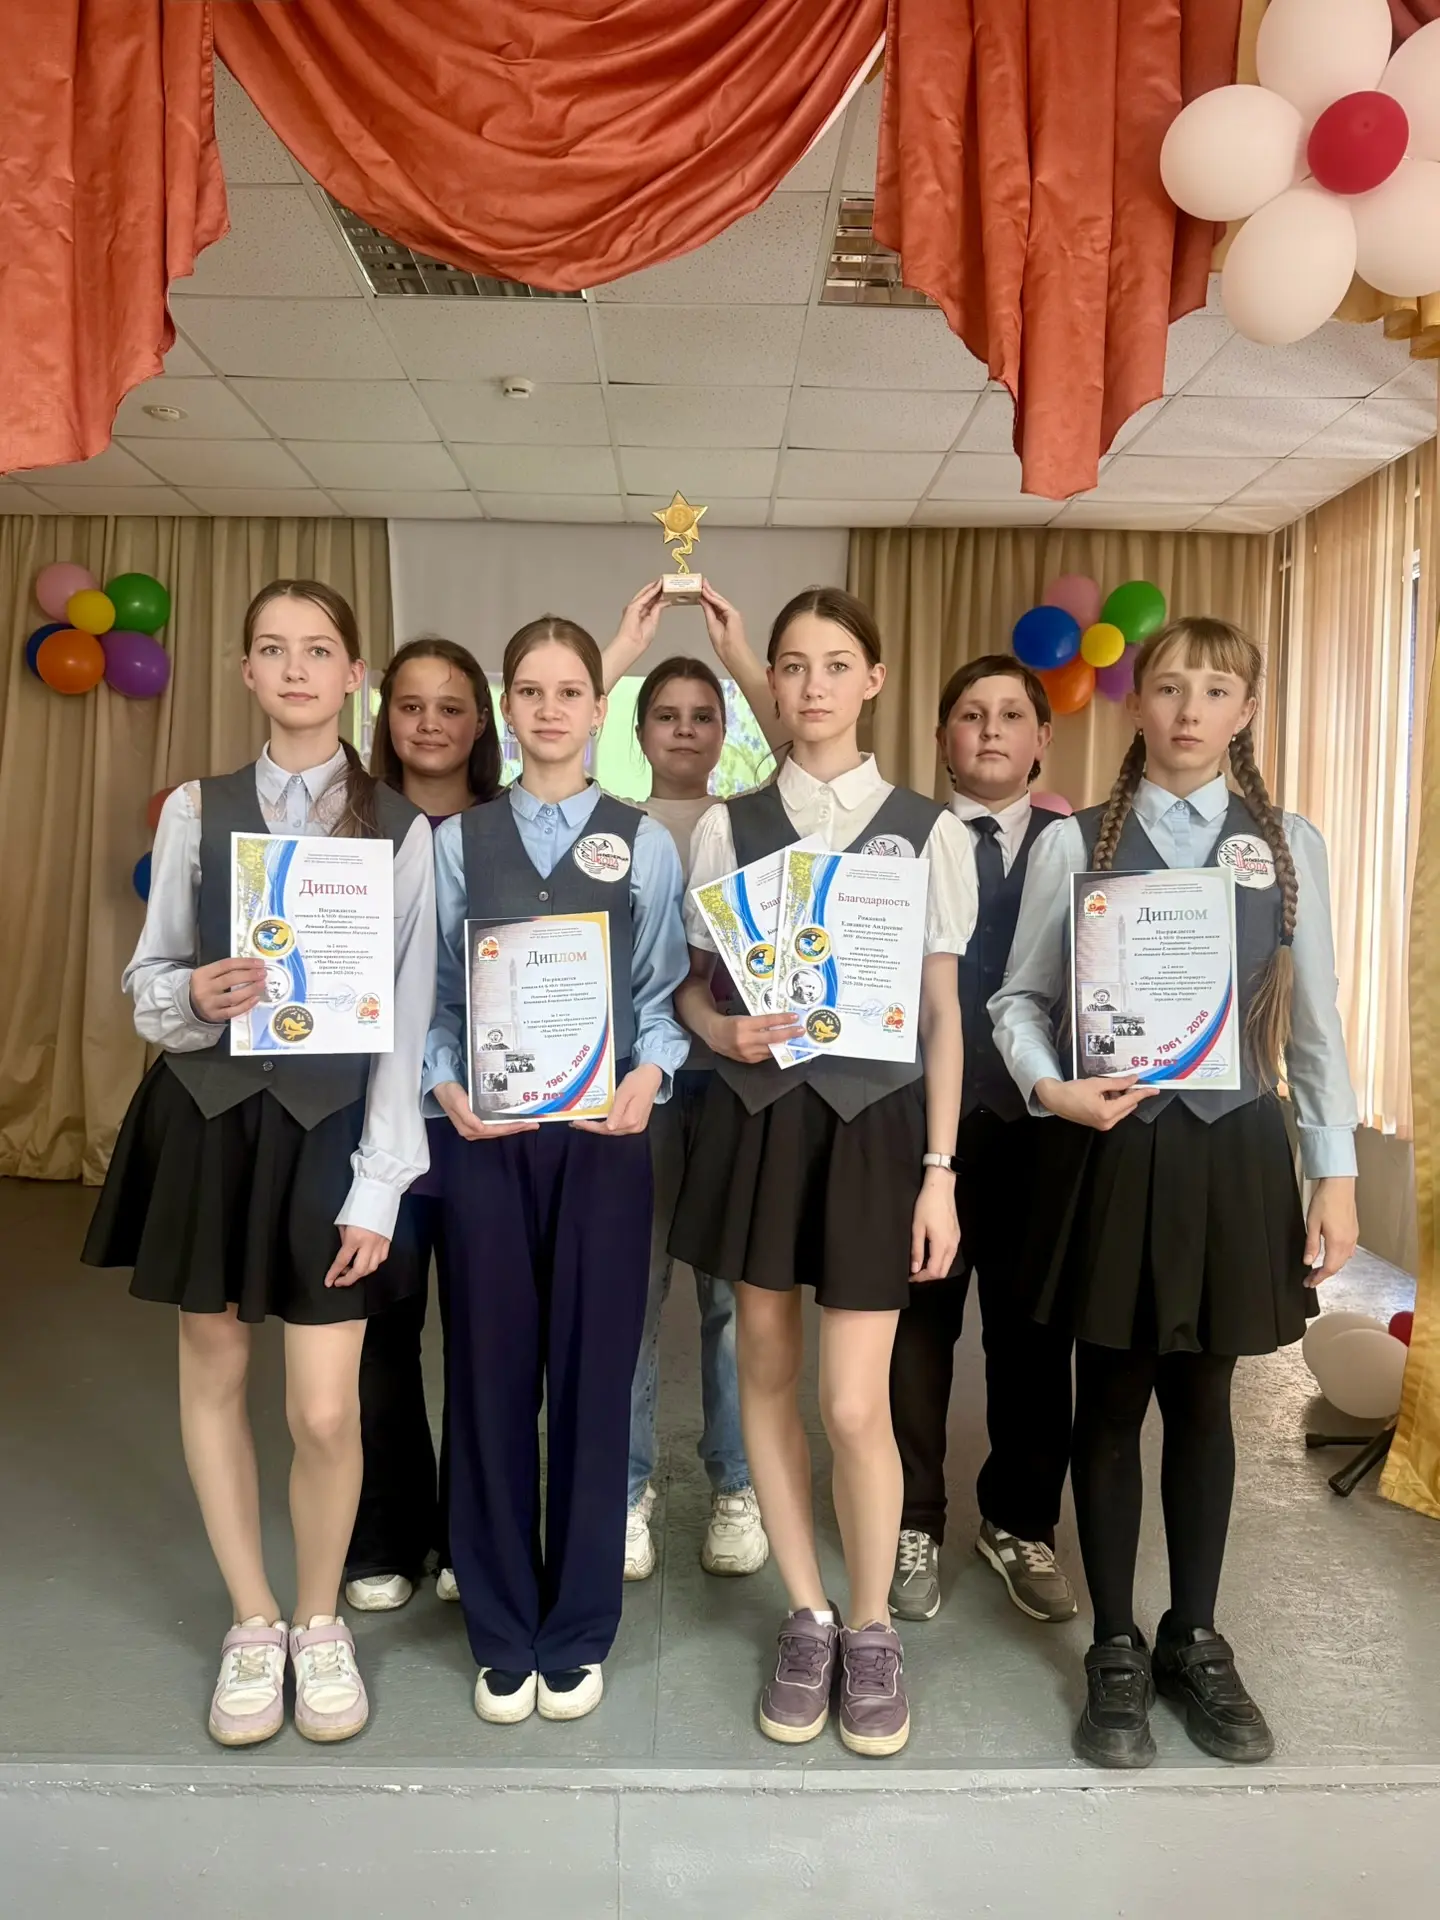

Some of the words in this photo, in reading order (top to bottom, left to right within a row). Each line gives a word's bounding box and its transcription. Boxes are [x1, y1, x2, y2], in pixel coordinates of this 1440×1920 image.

[299, 879, 368, 897] Диплом
[838, 892, 911, 907] Благодарность
[1137, 907, 1209, 924] Диплом
[526, 950, 588, 967] Диплом
[1156, 1037, 1182, 1055] 1961
[1186, 1009, 1210, 1035] 2026
[545, 1071, 569, 1089] 1961
[571, 1044, 591, 1069] 2026
[1131, 1056, 1149, 1067] 65
[1152, 1057, 1180, 1067] лет
[522, 1091, 539, 1102] 65
[542, 1091, 565, 1101] лет
